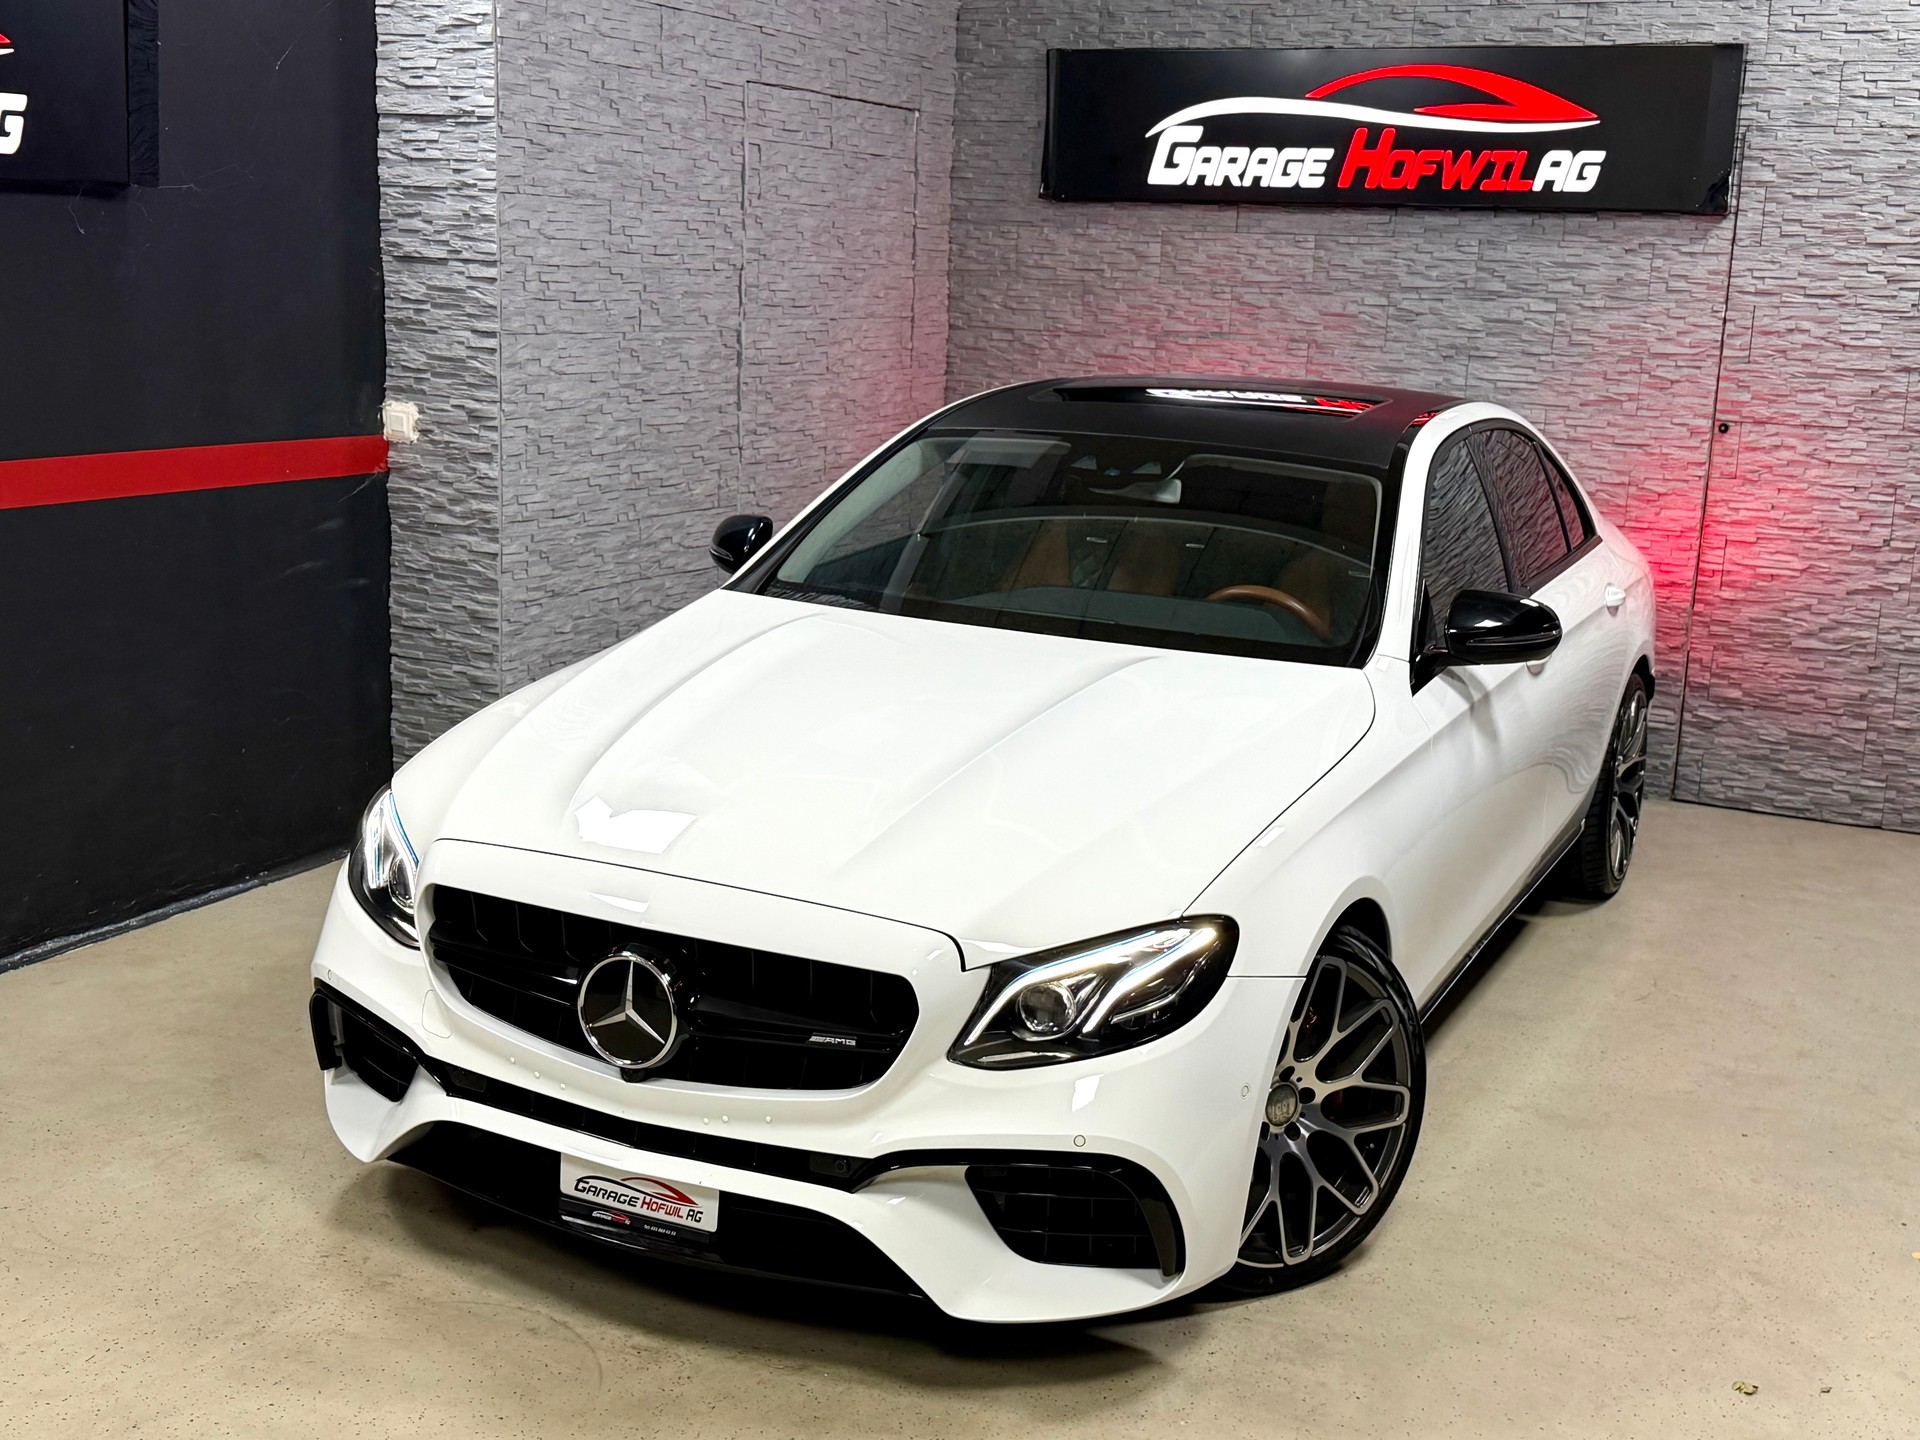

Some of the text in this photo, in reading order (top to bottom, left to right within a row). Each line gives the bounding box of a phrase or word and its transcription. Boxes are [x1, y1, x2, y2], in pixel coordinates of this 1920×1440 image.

[1146, 125, 1607, 193] GARAGE HOFWIL AG
[824, 1037, 856, 1046] AMG
[574, 1179, 703, 1223] GARAGE HOFWIL AG
